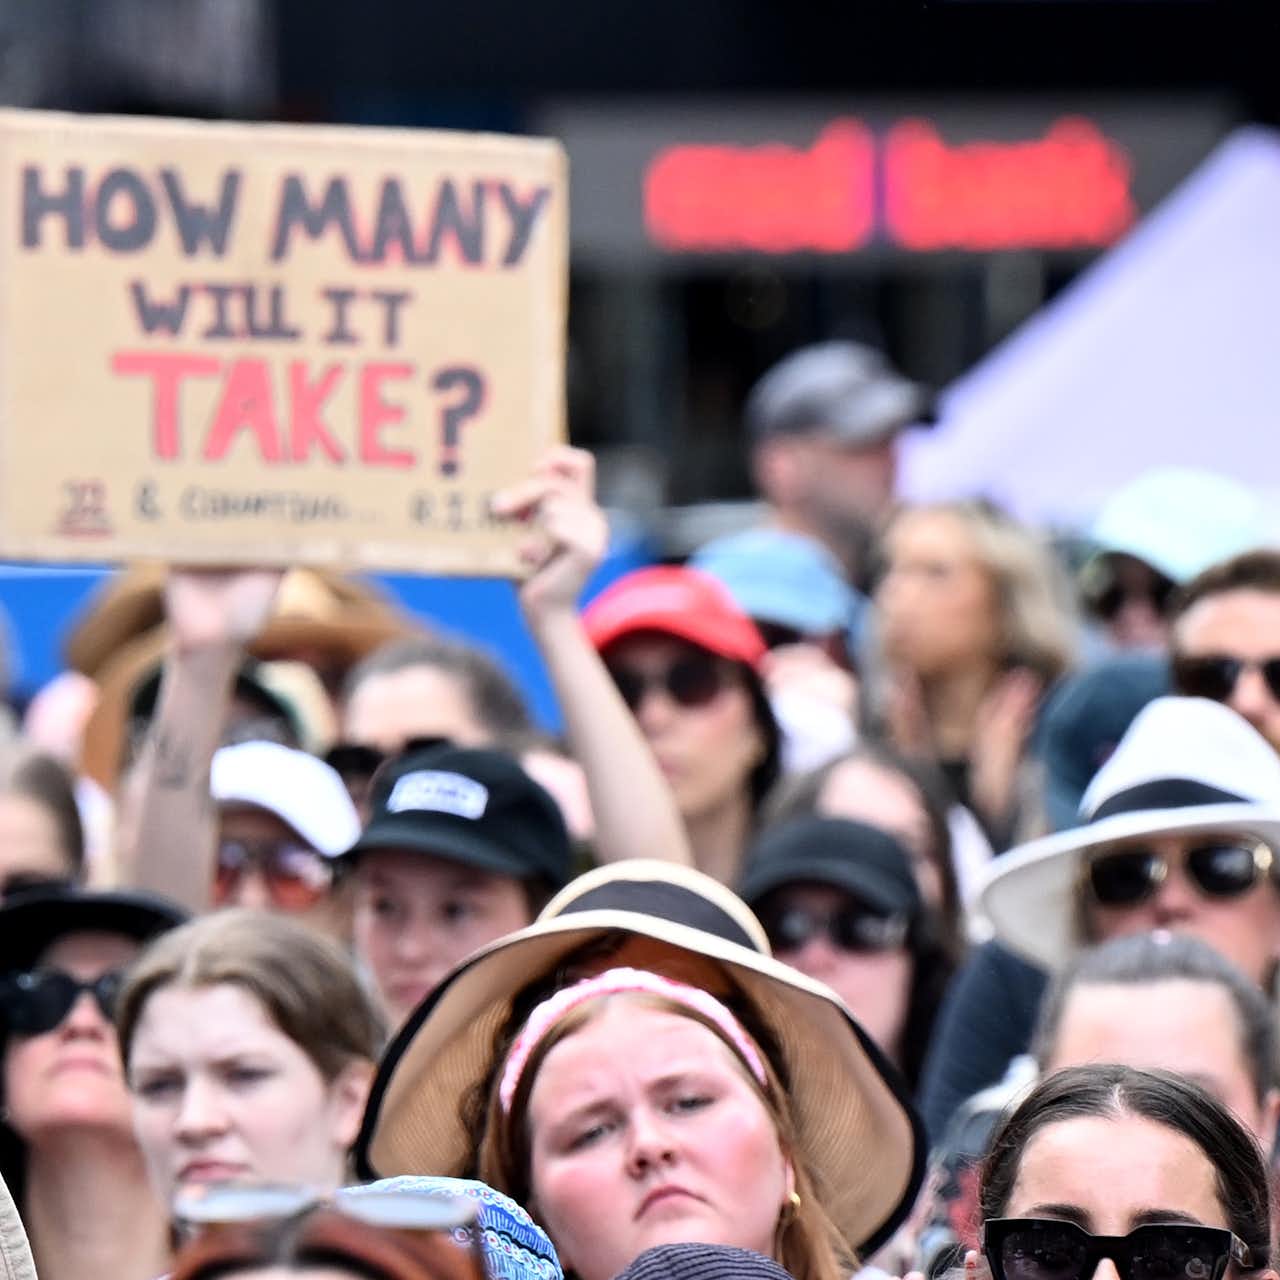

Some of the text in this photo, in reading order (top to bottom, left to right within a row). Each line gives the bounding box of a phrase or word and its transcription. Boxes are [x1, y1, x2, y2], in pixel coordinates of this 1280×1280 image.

[19, 164, 243, 259] HOW
[270, 172, 550, 268] MANY
[129, 280, 414, 346] WILL IT
[110, 352, 487, 478] TAKE?
